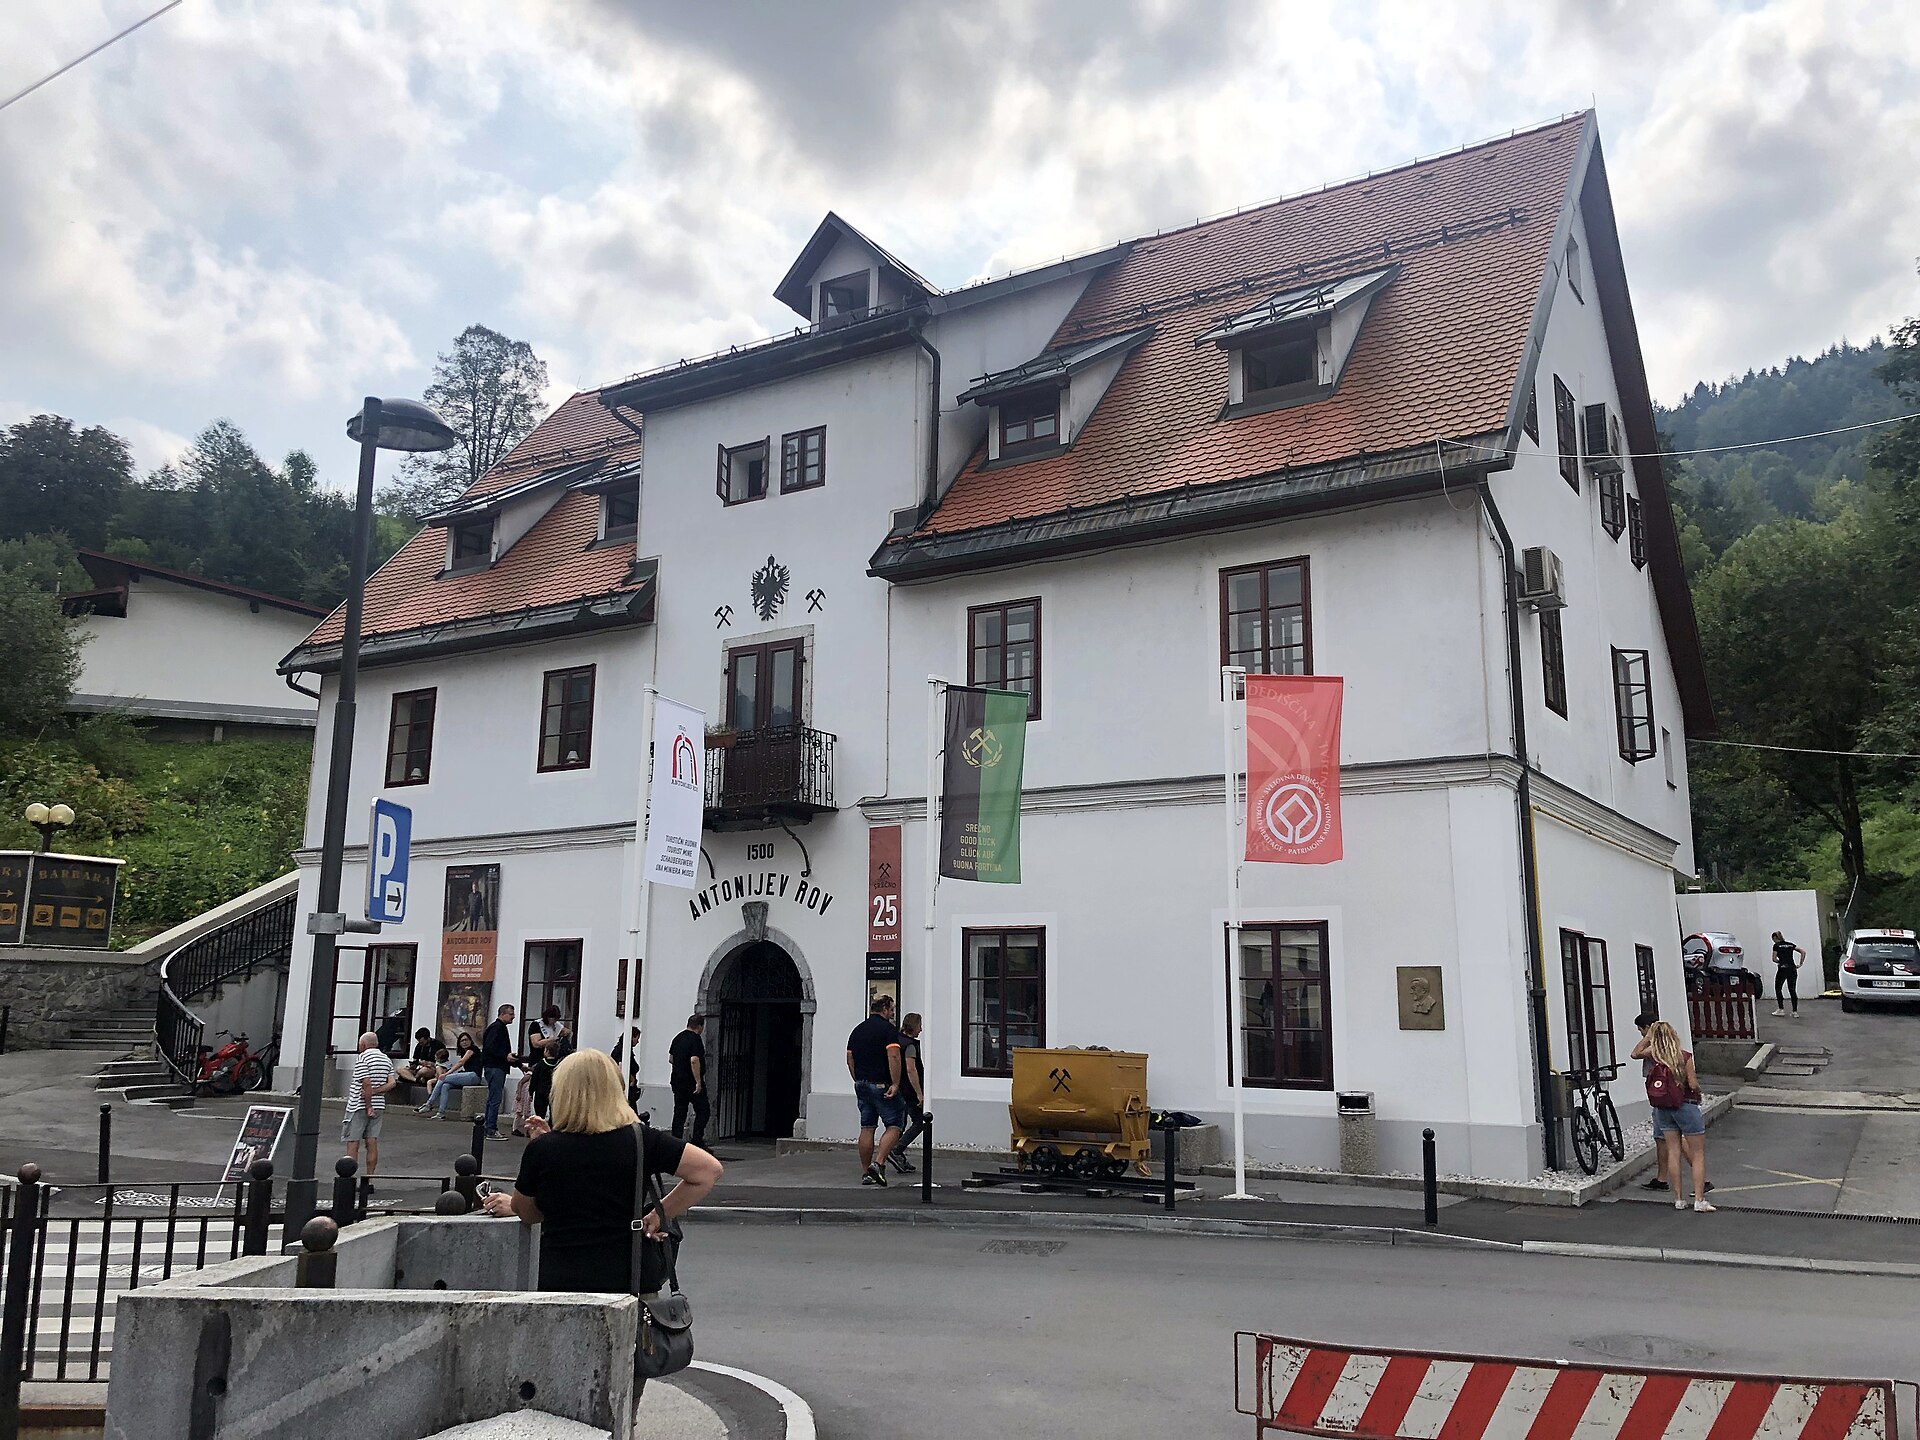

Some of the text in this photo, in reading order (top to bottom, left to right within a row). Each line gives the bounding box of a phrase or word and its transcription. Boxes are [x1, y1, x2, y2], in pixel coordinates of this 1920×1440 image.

[1263, 773, 1295, 795] SVETOVNA
[960, 835, 996, 848] GOOD LUCK
[1258, 826, 1284, 853] HERITAGE
[1287, 833, 1326, 855] PATRIMOINE
[373, 813, 397, 898] P
[747, 843, 775, 861] 1500
[981, 850, 996, 860] AUF
[39, 868, 110, 885] BARBARA
[688, 872, 834, 921] ANTONIJEV ROV
[873, 894, 898, 927] 25
[453, 953, 483, 966] 500.000
